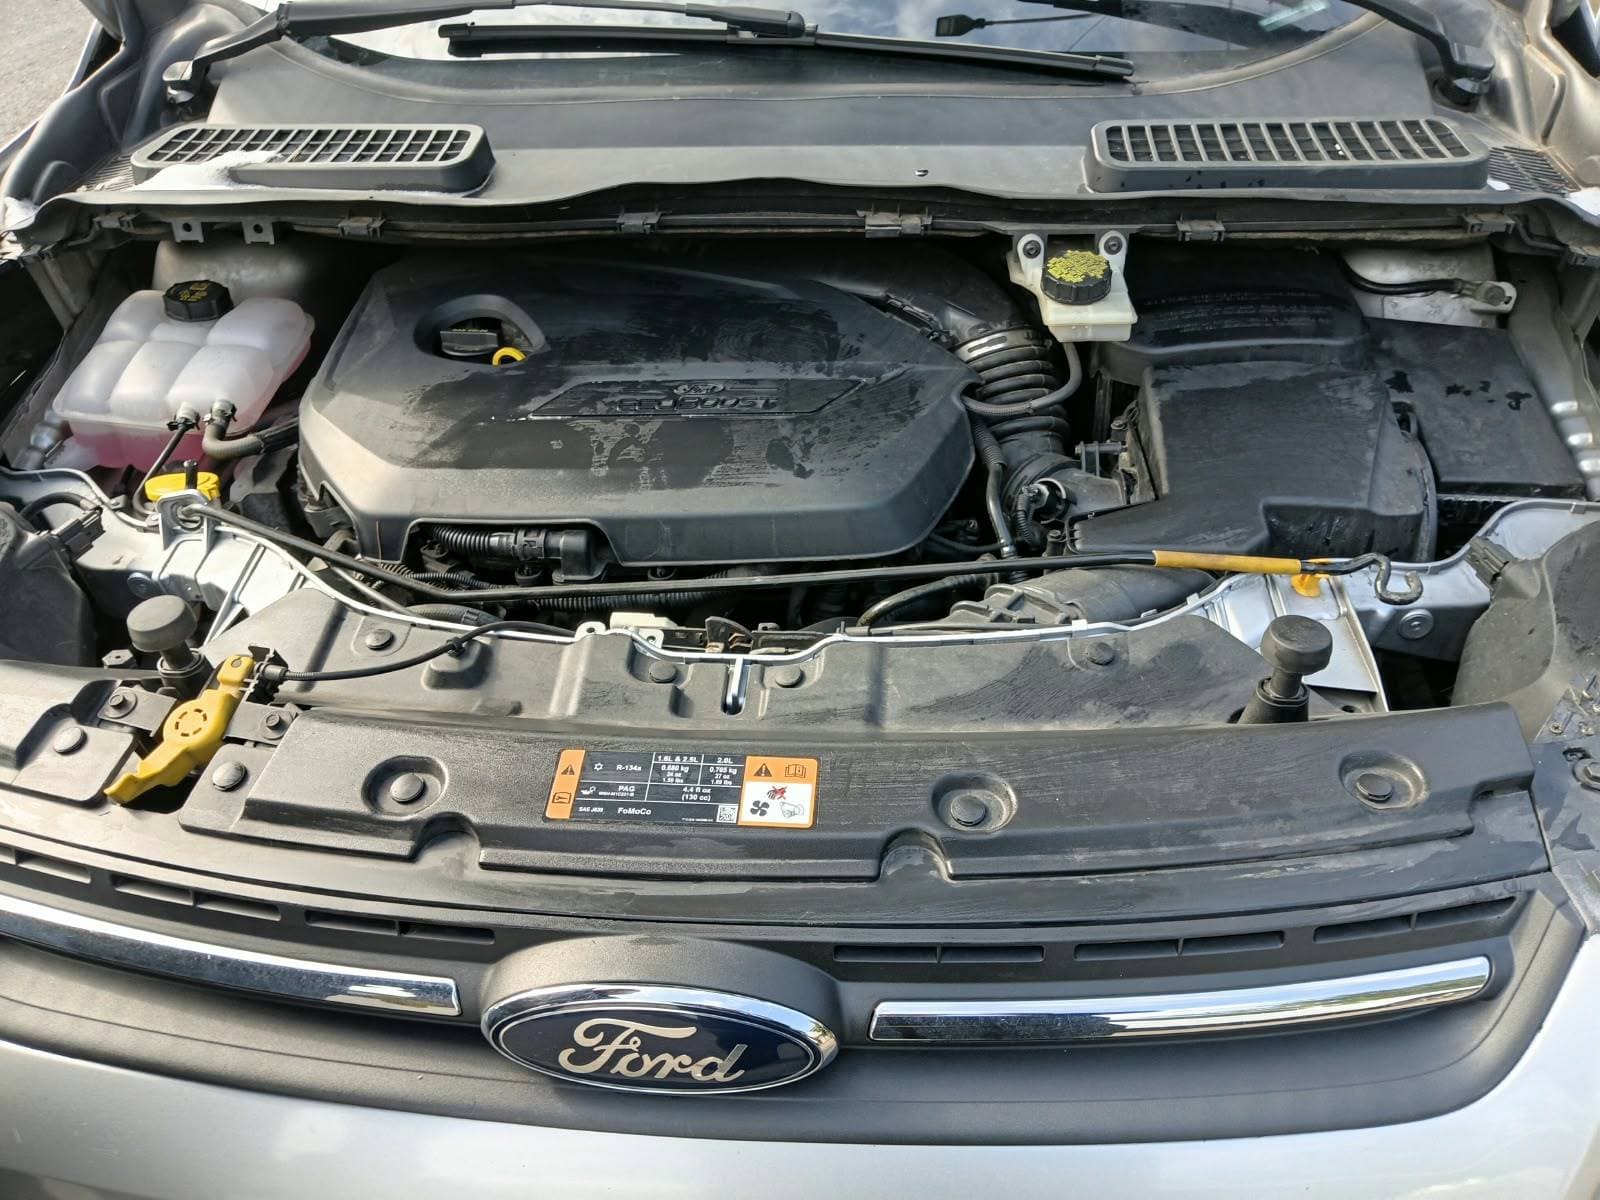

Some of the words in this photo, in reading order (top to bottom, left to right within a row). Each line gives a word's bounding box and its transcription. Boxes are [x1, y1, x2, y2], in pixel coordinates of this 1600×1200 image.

[680, 765, 690, 773] kg
[699, 794, 711, 802] cc)
[617, 807, 652, 815] FoMoCo
[558, 1018, 748, 1081] Ford
